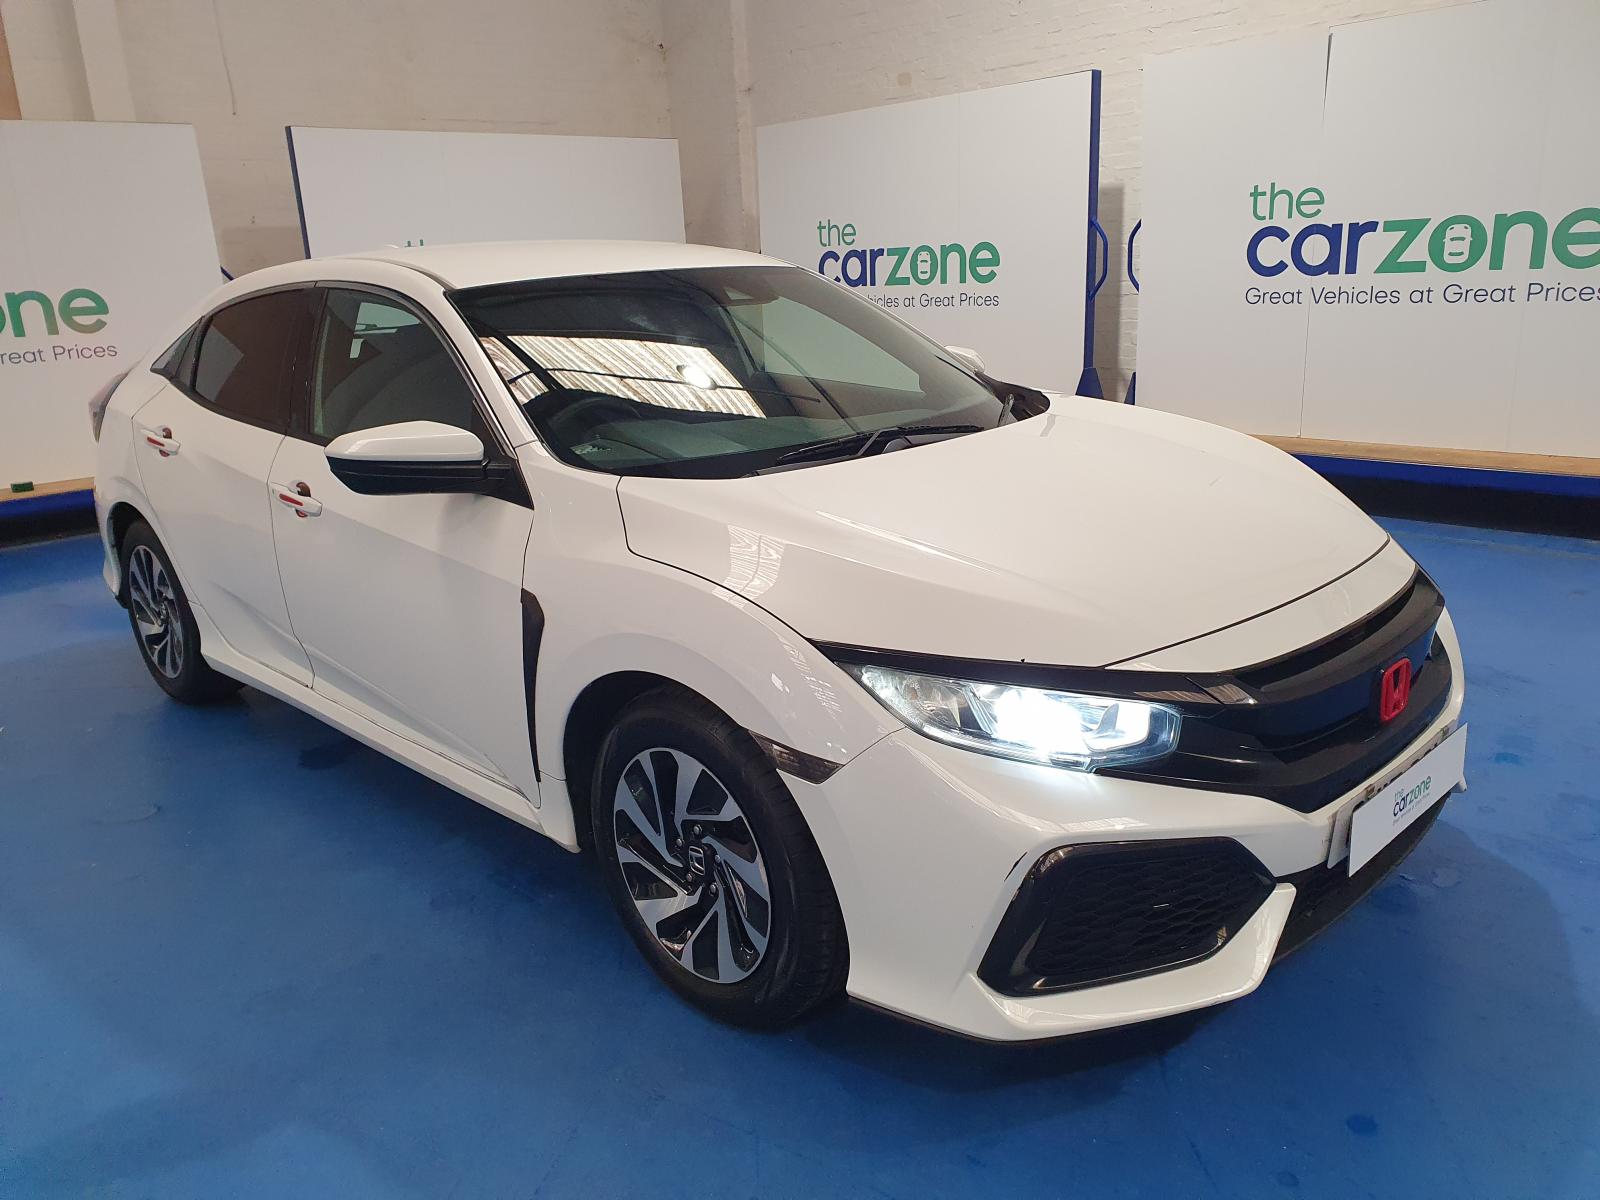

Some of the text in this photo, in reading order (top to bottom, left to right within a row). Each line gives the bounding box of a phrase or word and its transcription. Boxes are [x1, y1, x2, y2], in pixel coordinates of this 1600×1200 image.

[1250, 182, 1325, 220] the
[817, 219, 857, 247] the
[1247, 207, 1600, 277] carzone
[818, 242, 1000, 288] carzone
[903, 296, 915, 308] at
[919, 293, 954, 308] Great
[960, 292, 999, 307] Prices
[1245, 282, 1600, 305] Great Vehicles at Great Price
[0, 344, 117, 365] reat Prices
[1393, 775, 1432, 817] carzone
